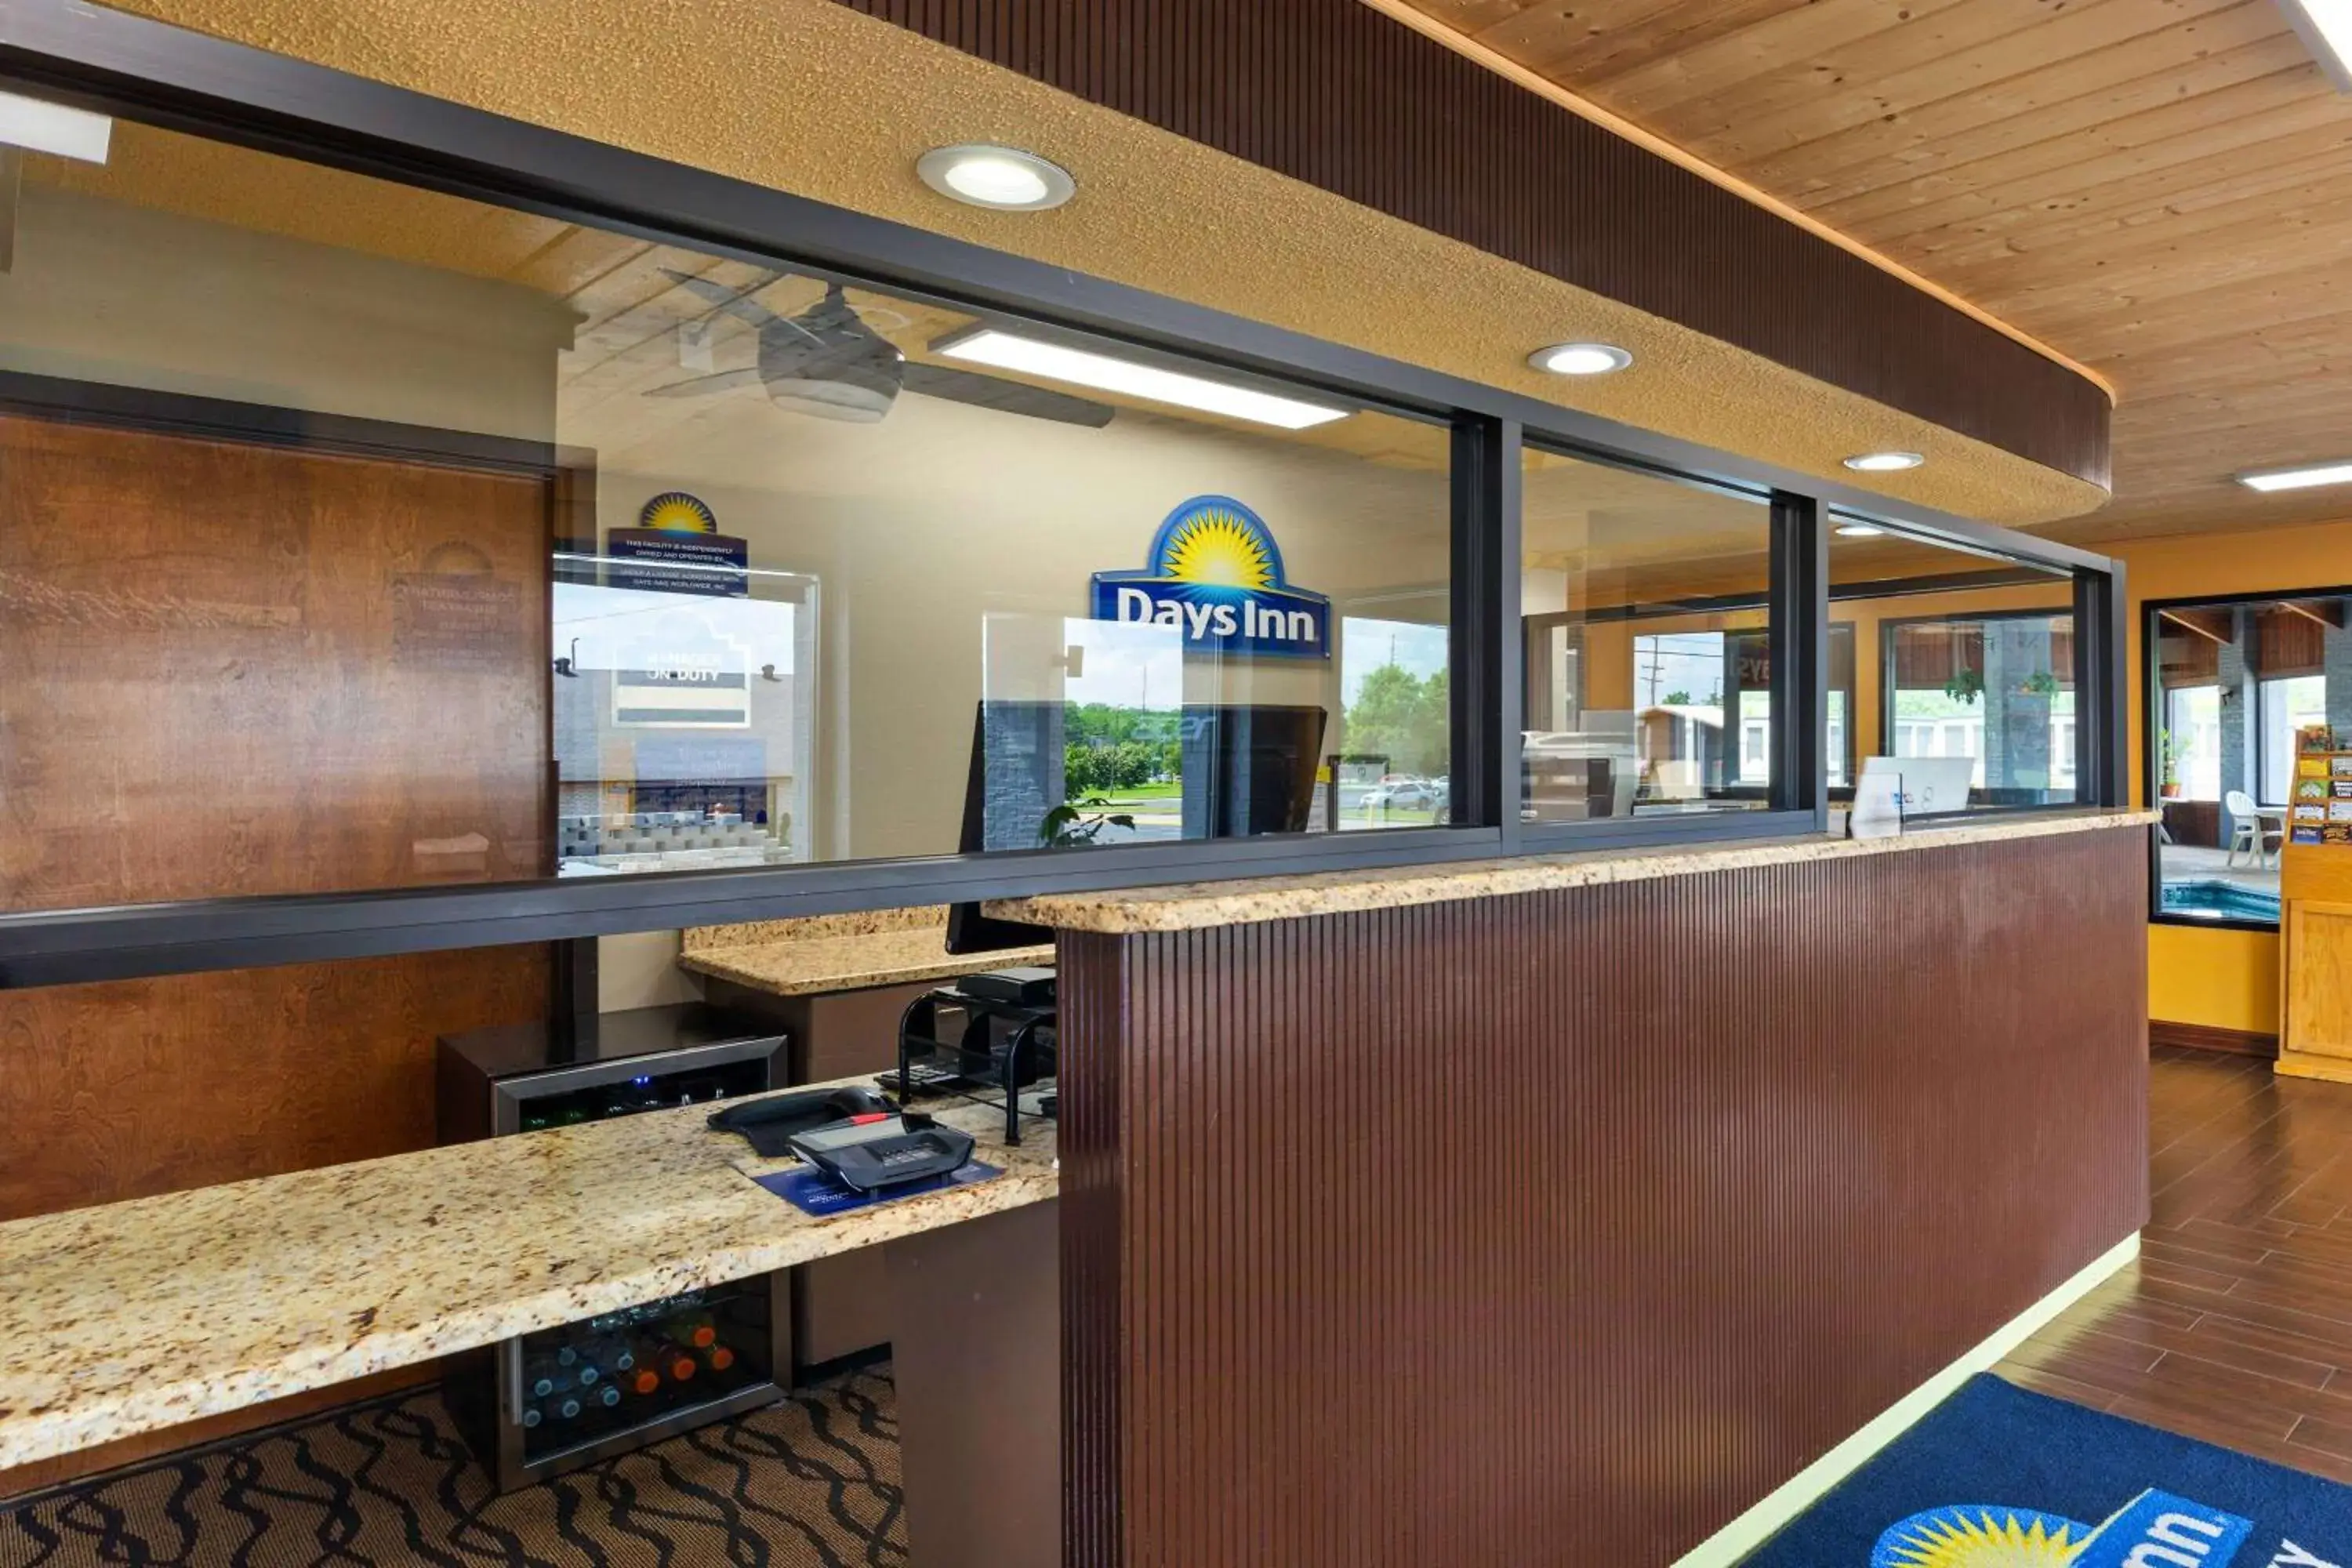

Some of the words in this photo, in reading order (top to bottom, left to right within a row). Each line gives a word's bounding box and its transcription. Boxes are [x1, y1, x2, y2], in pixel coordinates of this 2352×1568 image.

[1117, 587, 1238, 640] Days
[1244, 599, 1316, 641] Inn
[647, 669, 670, 680] ON
[677, 668, 720, 681] DUTY
